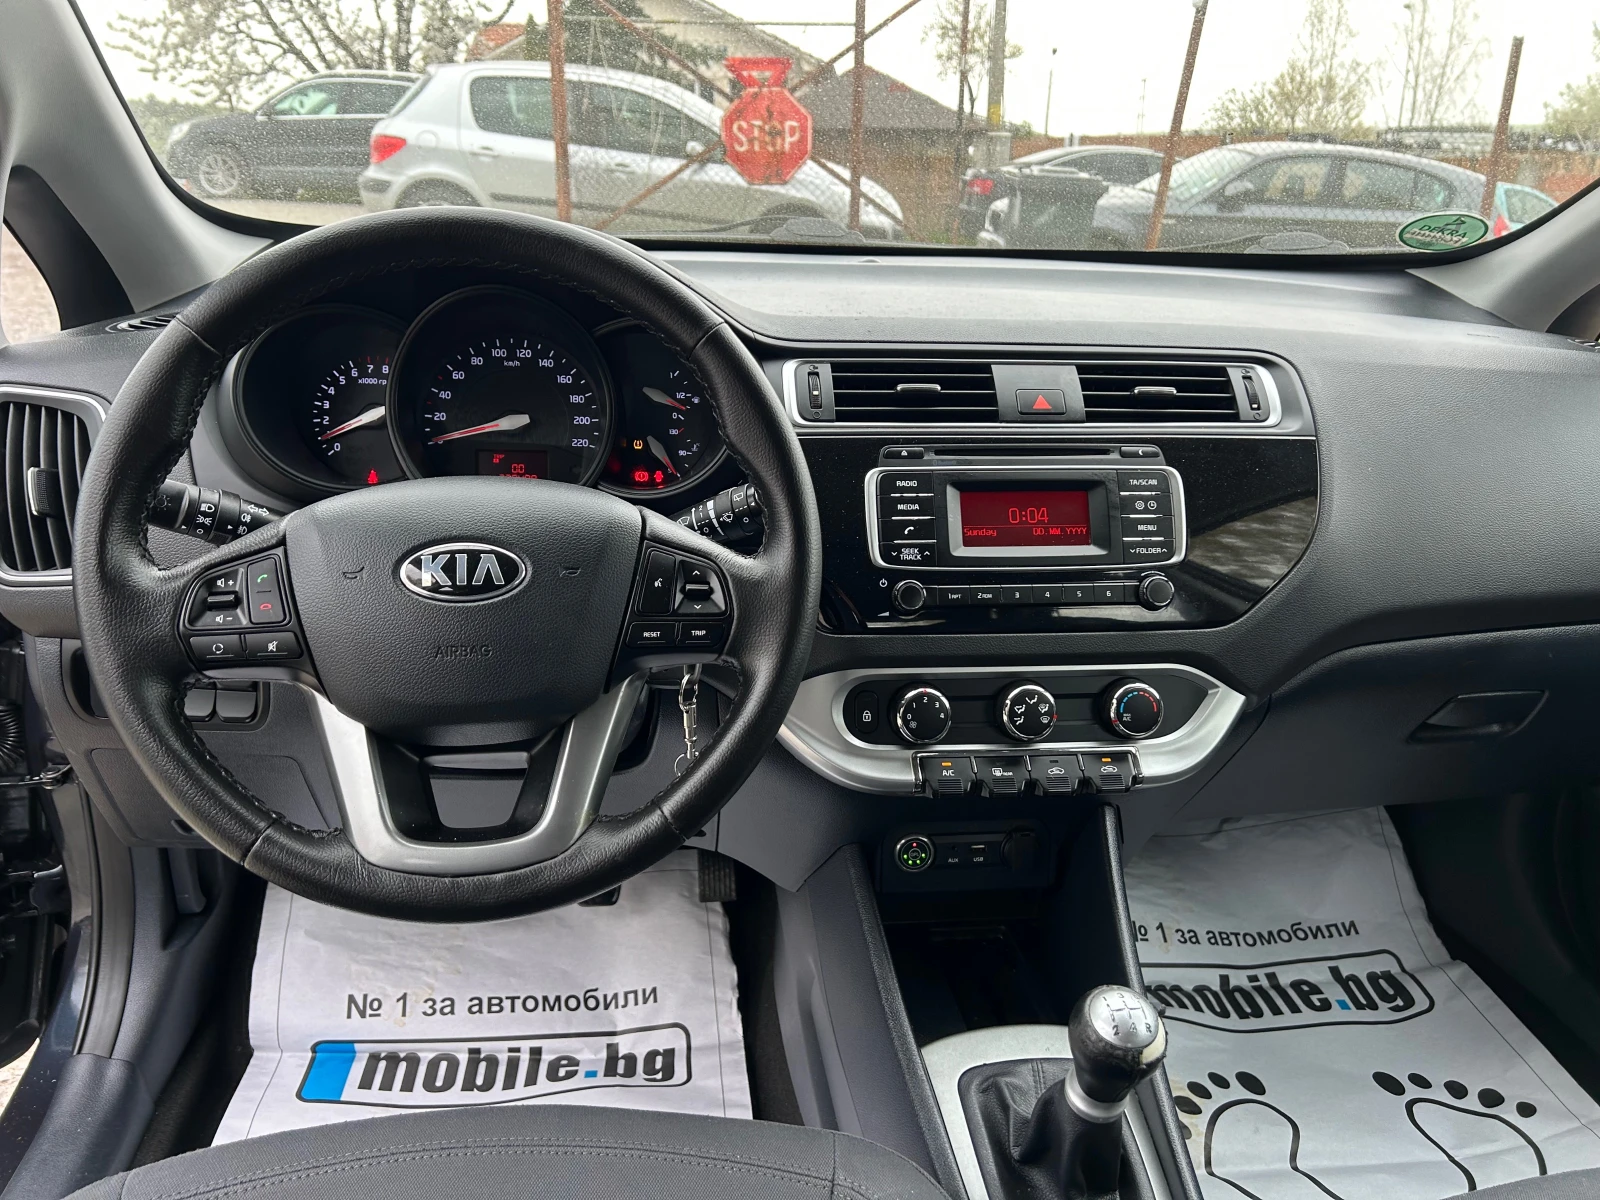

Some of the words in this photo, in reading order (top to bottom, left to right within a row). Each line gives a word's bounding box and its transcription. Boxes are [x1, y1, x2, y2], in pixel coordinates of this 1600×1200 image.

[732, 119, 801, 153] STOP
[1420, 224, 1467, 238] DEKRA
[491, 349, 507, 357] 100
[516, 349, 532, 358] 120
[471, 357, 483, 365] 80
[538, 359, 554, 367] 140
[351, 368, 358, 377] 6
[367, 364, 374, 373] 7
[382, 365, 389, 374] 8
[452, 371, 465, 379] 60
[339, 376, 346, 384] 5
[557, 376, 572, 384] 160
[327, 387, 335, 395] 4
[439, 391, 451, 399] 40
[569, 395, 584, 403] 180
[323, 401, 330, 409] 3
[323, 416, 330, 424] 2
[433, 412, 446, 420] 20
[573, 417, 590, 425] 200
[334, 443, 341, 451] 0
[572, 439, 588, 447] 220
[1129, 478, 1158, 486] TA/SCAN
[1008, 507, 1049, 524] 0:04
[964, 527, 997, 538] Sunday
[420, 553, 505, 587] KIA
[434, 644, 493, 659] AIRBAG
[1155, 921, 1168, 944] 1
[1175, 928, 1201, 945] за
[1206, 920, 1360, 948] автомобили
[1146, 965, 1416, 1020] mobile.bg
[396, 992, 409, 1018] 1
[422, 995, 456, 1017] за
[467, 986, 659, 1016] автомобили
[1112, 1024, 1121, 1036] 2
[357, 1042, 676, 1093] mobile.bg
